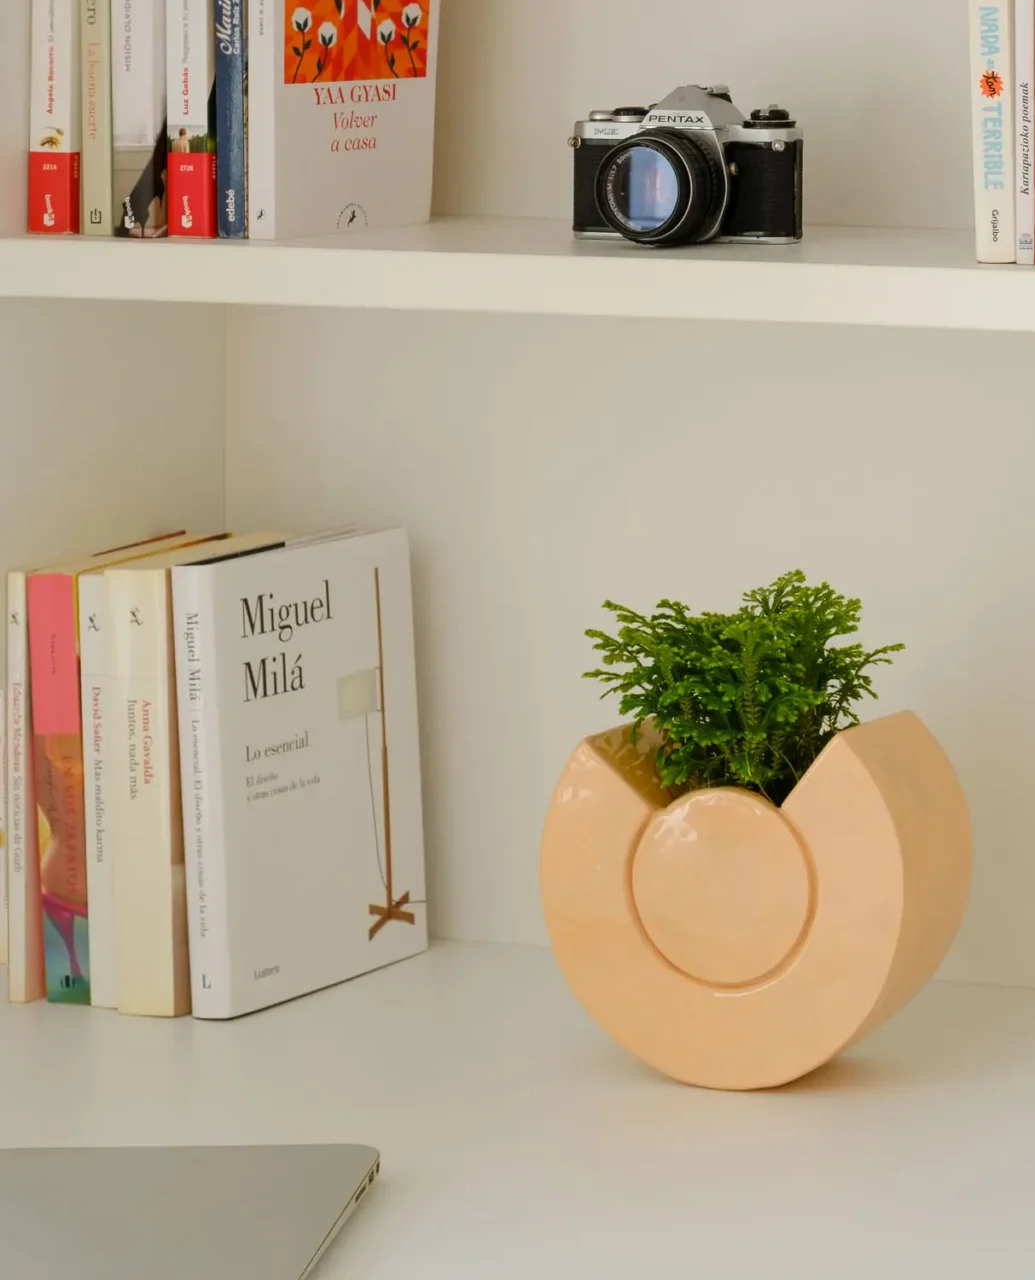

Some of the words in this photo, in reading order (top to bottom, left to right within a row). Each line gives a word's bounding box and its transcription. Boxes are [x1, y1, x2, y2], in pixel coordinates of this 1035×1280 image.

[232, 5, 240, 26] Ruiz
[979, 6, 1000, 56] NADA
[88, 42, 101, 56] La
[124, 36, 132, 73] MISIÓN
[232, 28, 240, 55] Carlos
[88, 59, 101, 97] buena
[314, 86, 345, 106] YAA
[350, 83, 397, 104] GYASI
[982, 71, 998, 98] tan
[649, 114, 704, 124] PENTAX
[1019, 82, 1031, 123] poemak
[88, 99, 98, 140] suerte
[333, 110, 378, 130] Volver
[593, 128, 619, 136] ME
[330, 139, 340, 152] a
[344, 136, 378, 152] casa
[1020, 125, 1032, 196] Kartapazioko
[228, 189, 236, 222] edebé
[240, 579, 333, 642] Miguel
[183, 613, 201, 662] Miguel
[188, 668, 202, 701] Milá
[242, 652, 305, 703] Milá
[92, 686, 101, 722] David
[127, 699, 138, 741] Juntos,
[142, 699, 151, 732] Anna
[93, 723, 104, 753] Safier
[191, 720, 200, 733] Lo
[129, 743, 139, 772] nada
[143, 735, 154, 785] Gavalda
[246, 745, 261, 762] Lo
[264, 729, 309, 758] esencial
[94, 759, 104, 781] Más
[194, 779, 203, 791] El
[246, 776, 254, 787] El
[130, 774, 139, 800] más
[95, 784, 105, 826] maldito
[96, 828, 105, 863] karma
[202, 973, 212, 989] L
